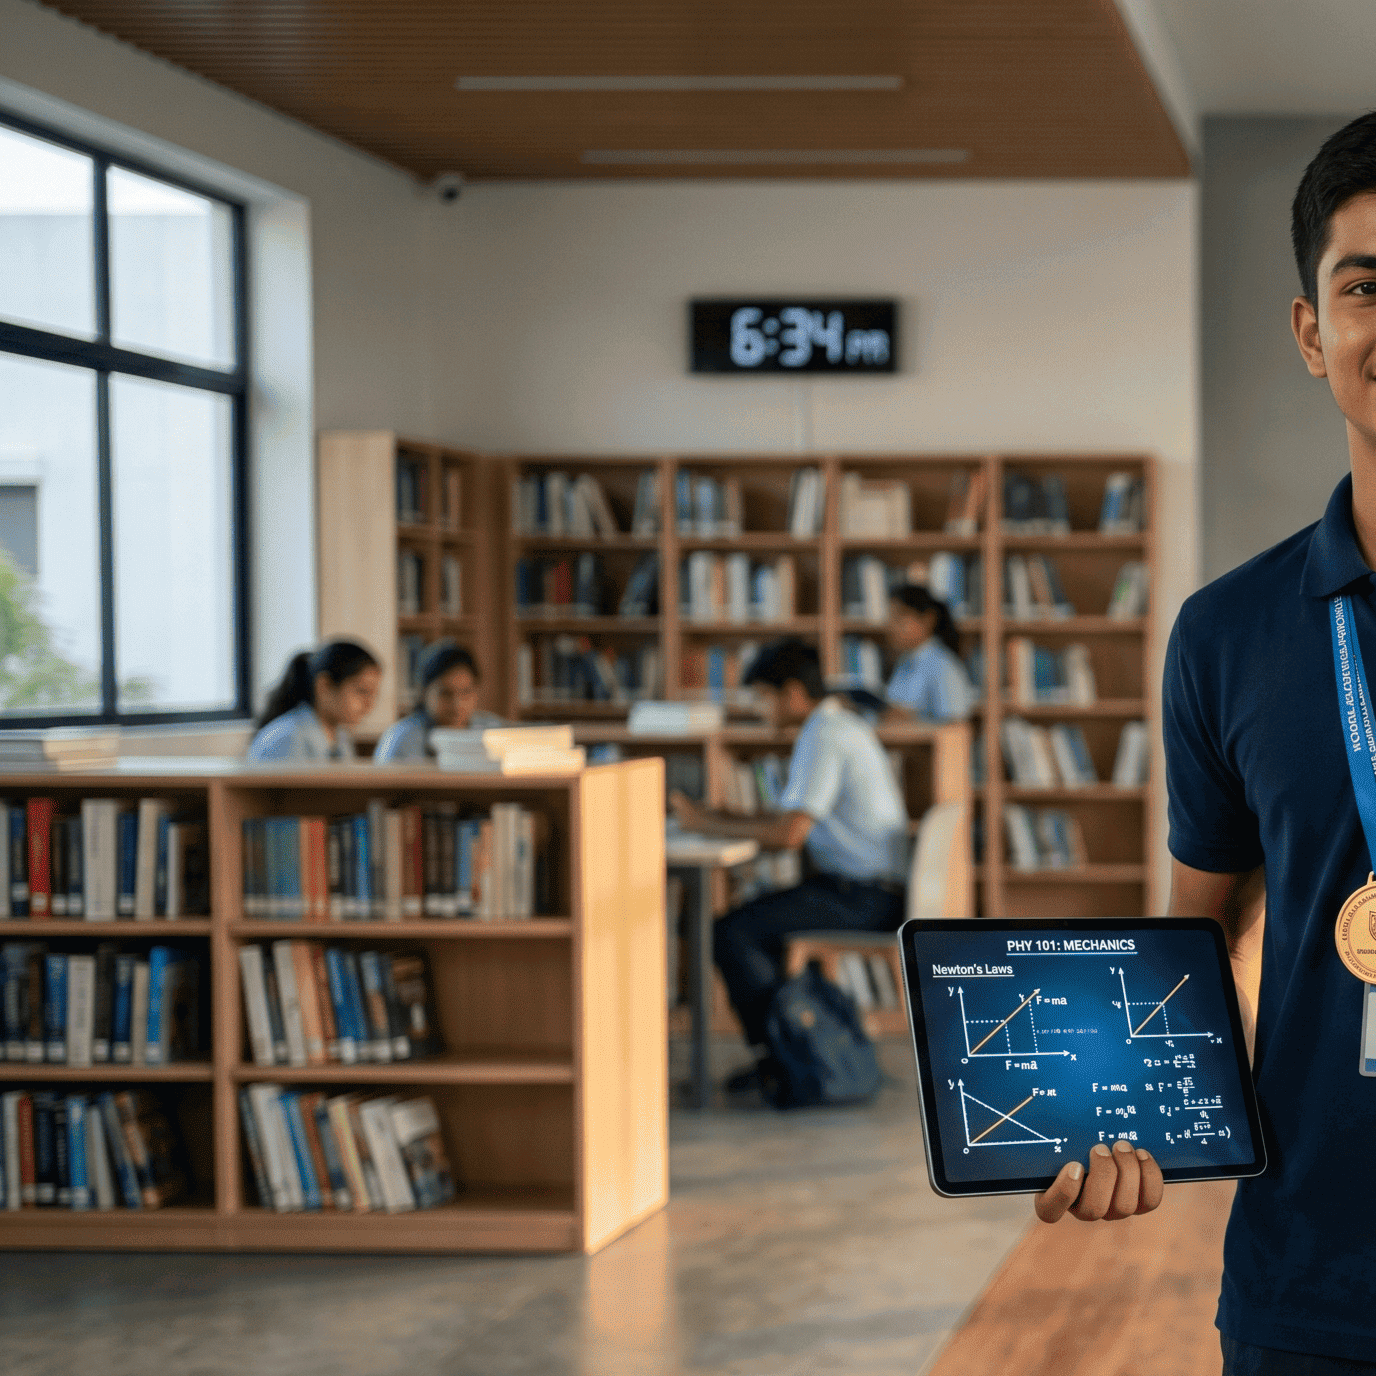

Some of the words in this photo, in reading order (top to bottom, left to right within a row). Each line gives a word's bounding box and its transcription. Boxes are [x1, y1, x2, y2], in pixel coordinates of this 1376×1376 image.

[730, 306, 844, 367] 6:34
[1006, 940, 1033, 951] PHY
[1035, 940, 1061, 951] 101:
[1063, 939, 1136, 951] MECHANICS
[932, 963, 984, 975] Newton's
[985, 963, 1013, 975] Laws
